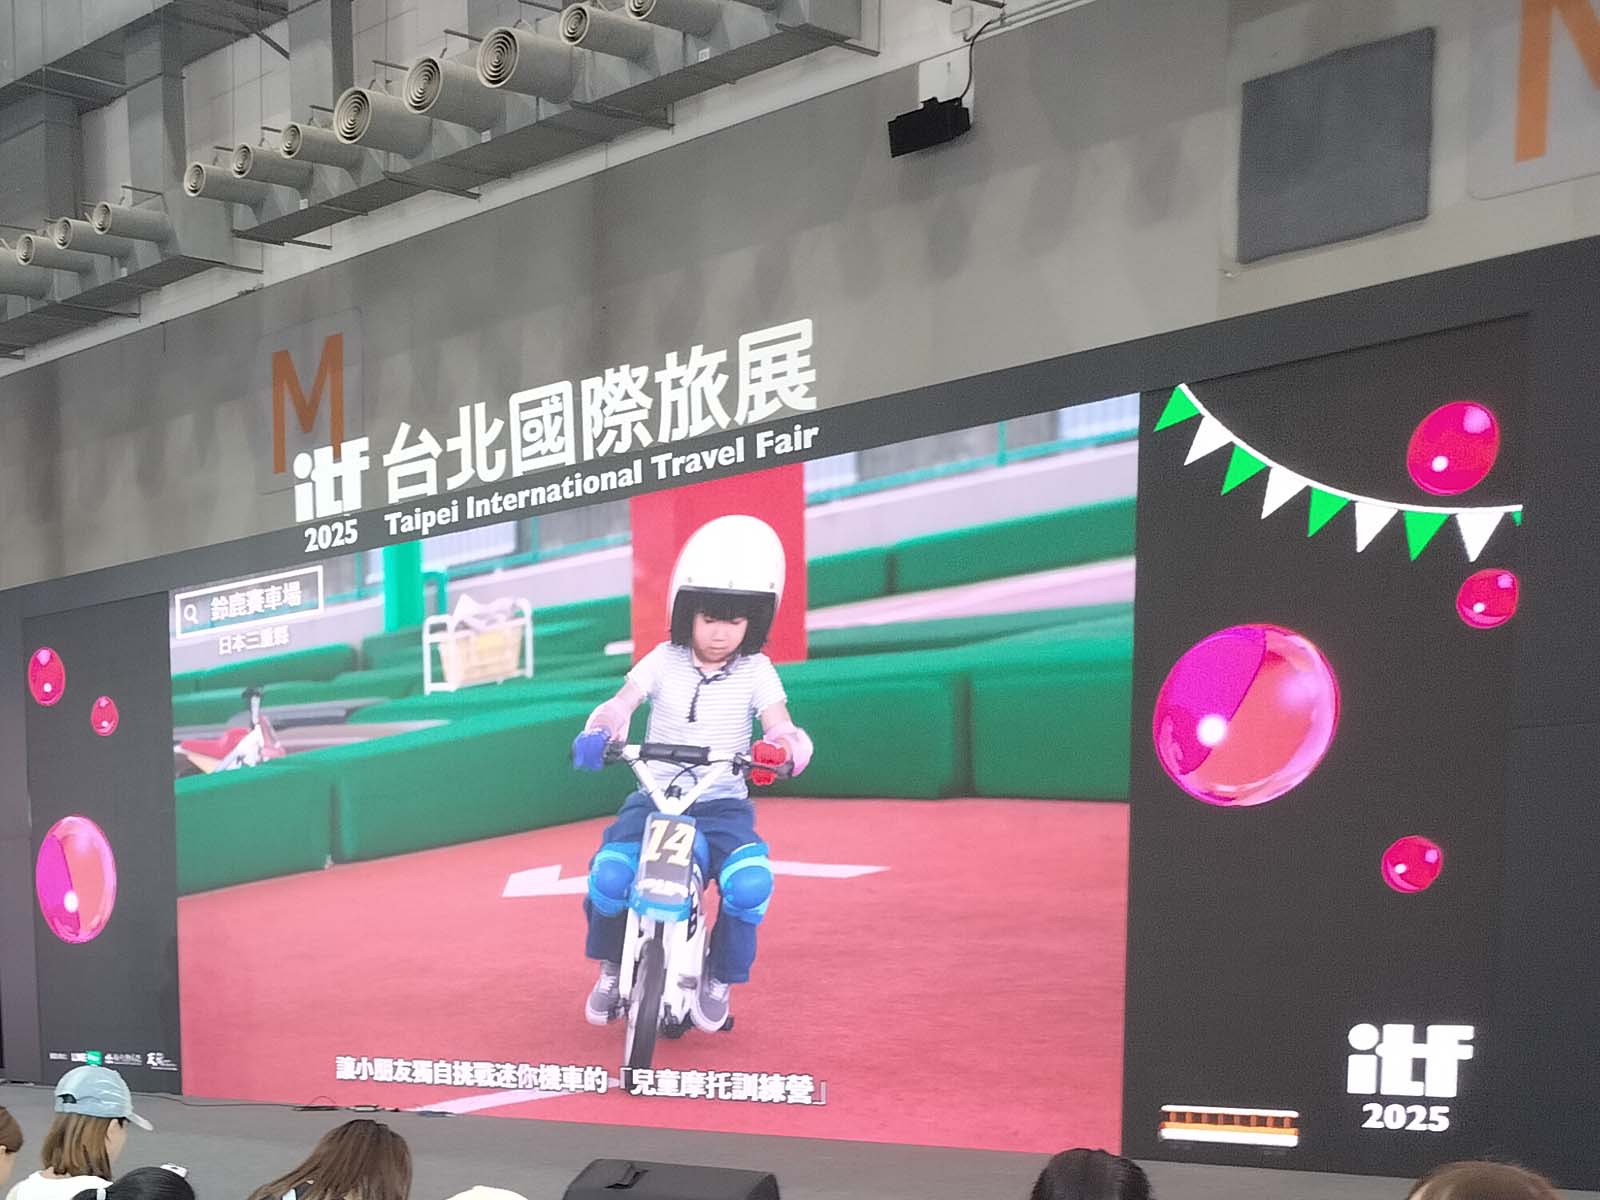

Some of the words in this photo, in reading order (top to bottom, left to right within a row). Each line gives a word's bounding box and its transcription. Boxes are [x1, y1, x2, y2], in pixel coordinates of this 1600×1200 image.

[272, 332, 345, 474] M
[382, 318, 818, 504] 台北國際旅展
[303, 521, 358, 554] 2025
[384, 499, 460, 537] Taipei
[466, 466, 643, 519] International
[652, 428, 746, 482] Travel
[755, 422, 819, 461] Fair
[1362, 1102, 1450, 1133] 2025
